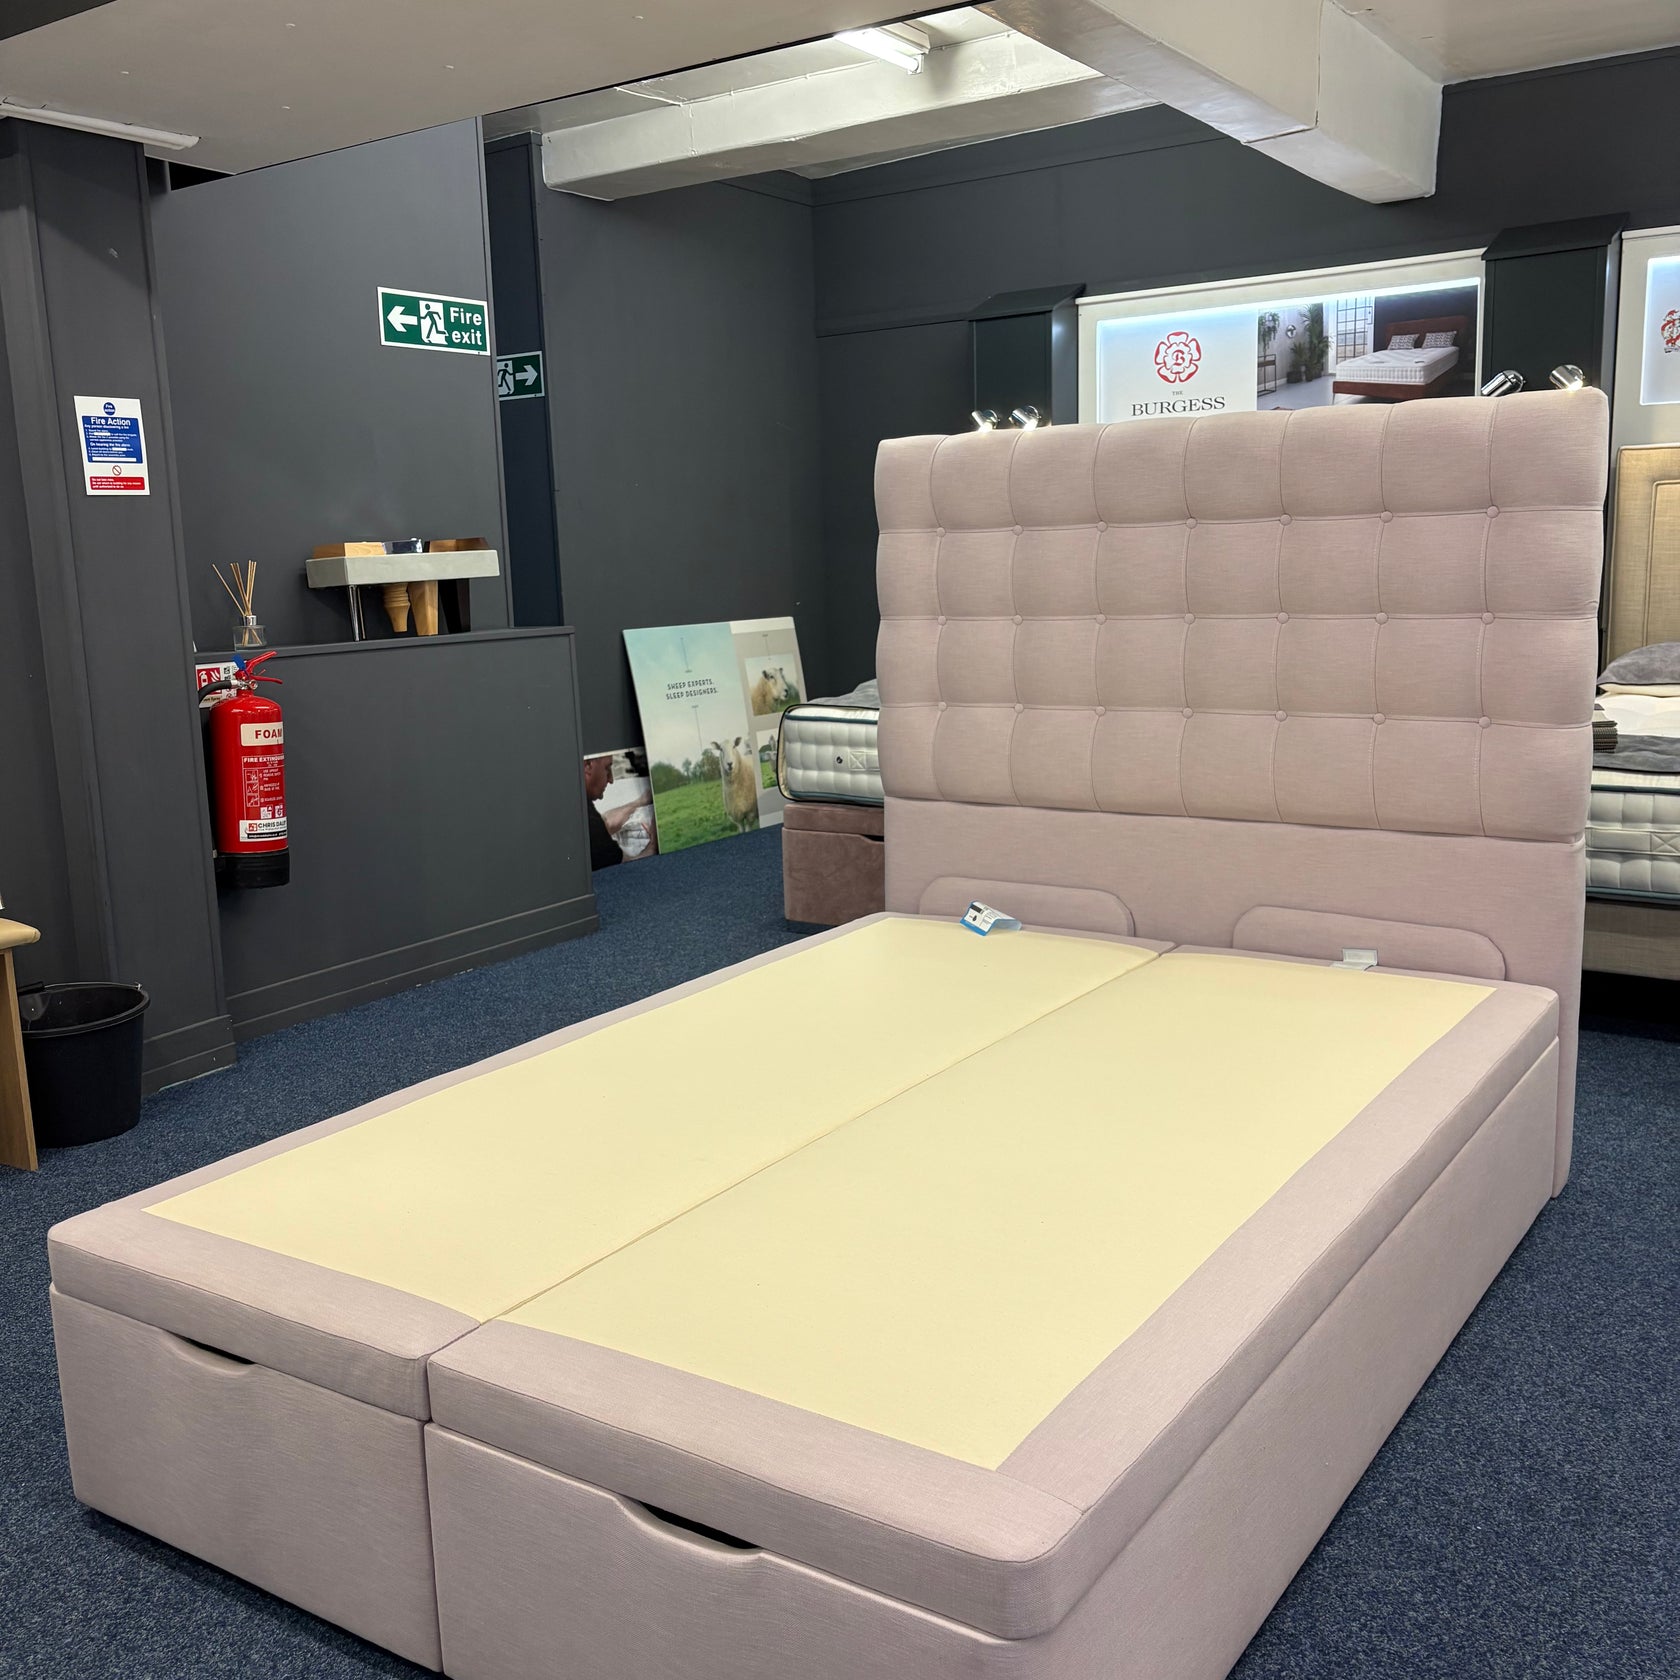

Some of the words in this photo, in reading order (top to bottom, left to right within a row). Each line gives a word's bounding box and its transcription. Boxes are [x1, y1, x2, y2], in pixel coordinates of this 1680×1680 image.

[450, 307, 482, 325] Fire
[452, 329, 482, 345] exit
[1132, 396, 1226, 416] BURGESS
[91, 417, 106, 425] Fire
[107, 418, 131, 426] Action
[667, 682, 687, 690] SHEEP
[687, 678, 715, 688] EXPERTS.
[666, 691, 684, 700] SLEEP
[258, 821, 276, 829] CHRIS
